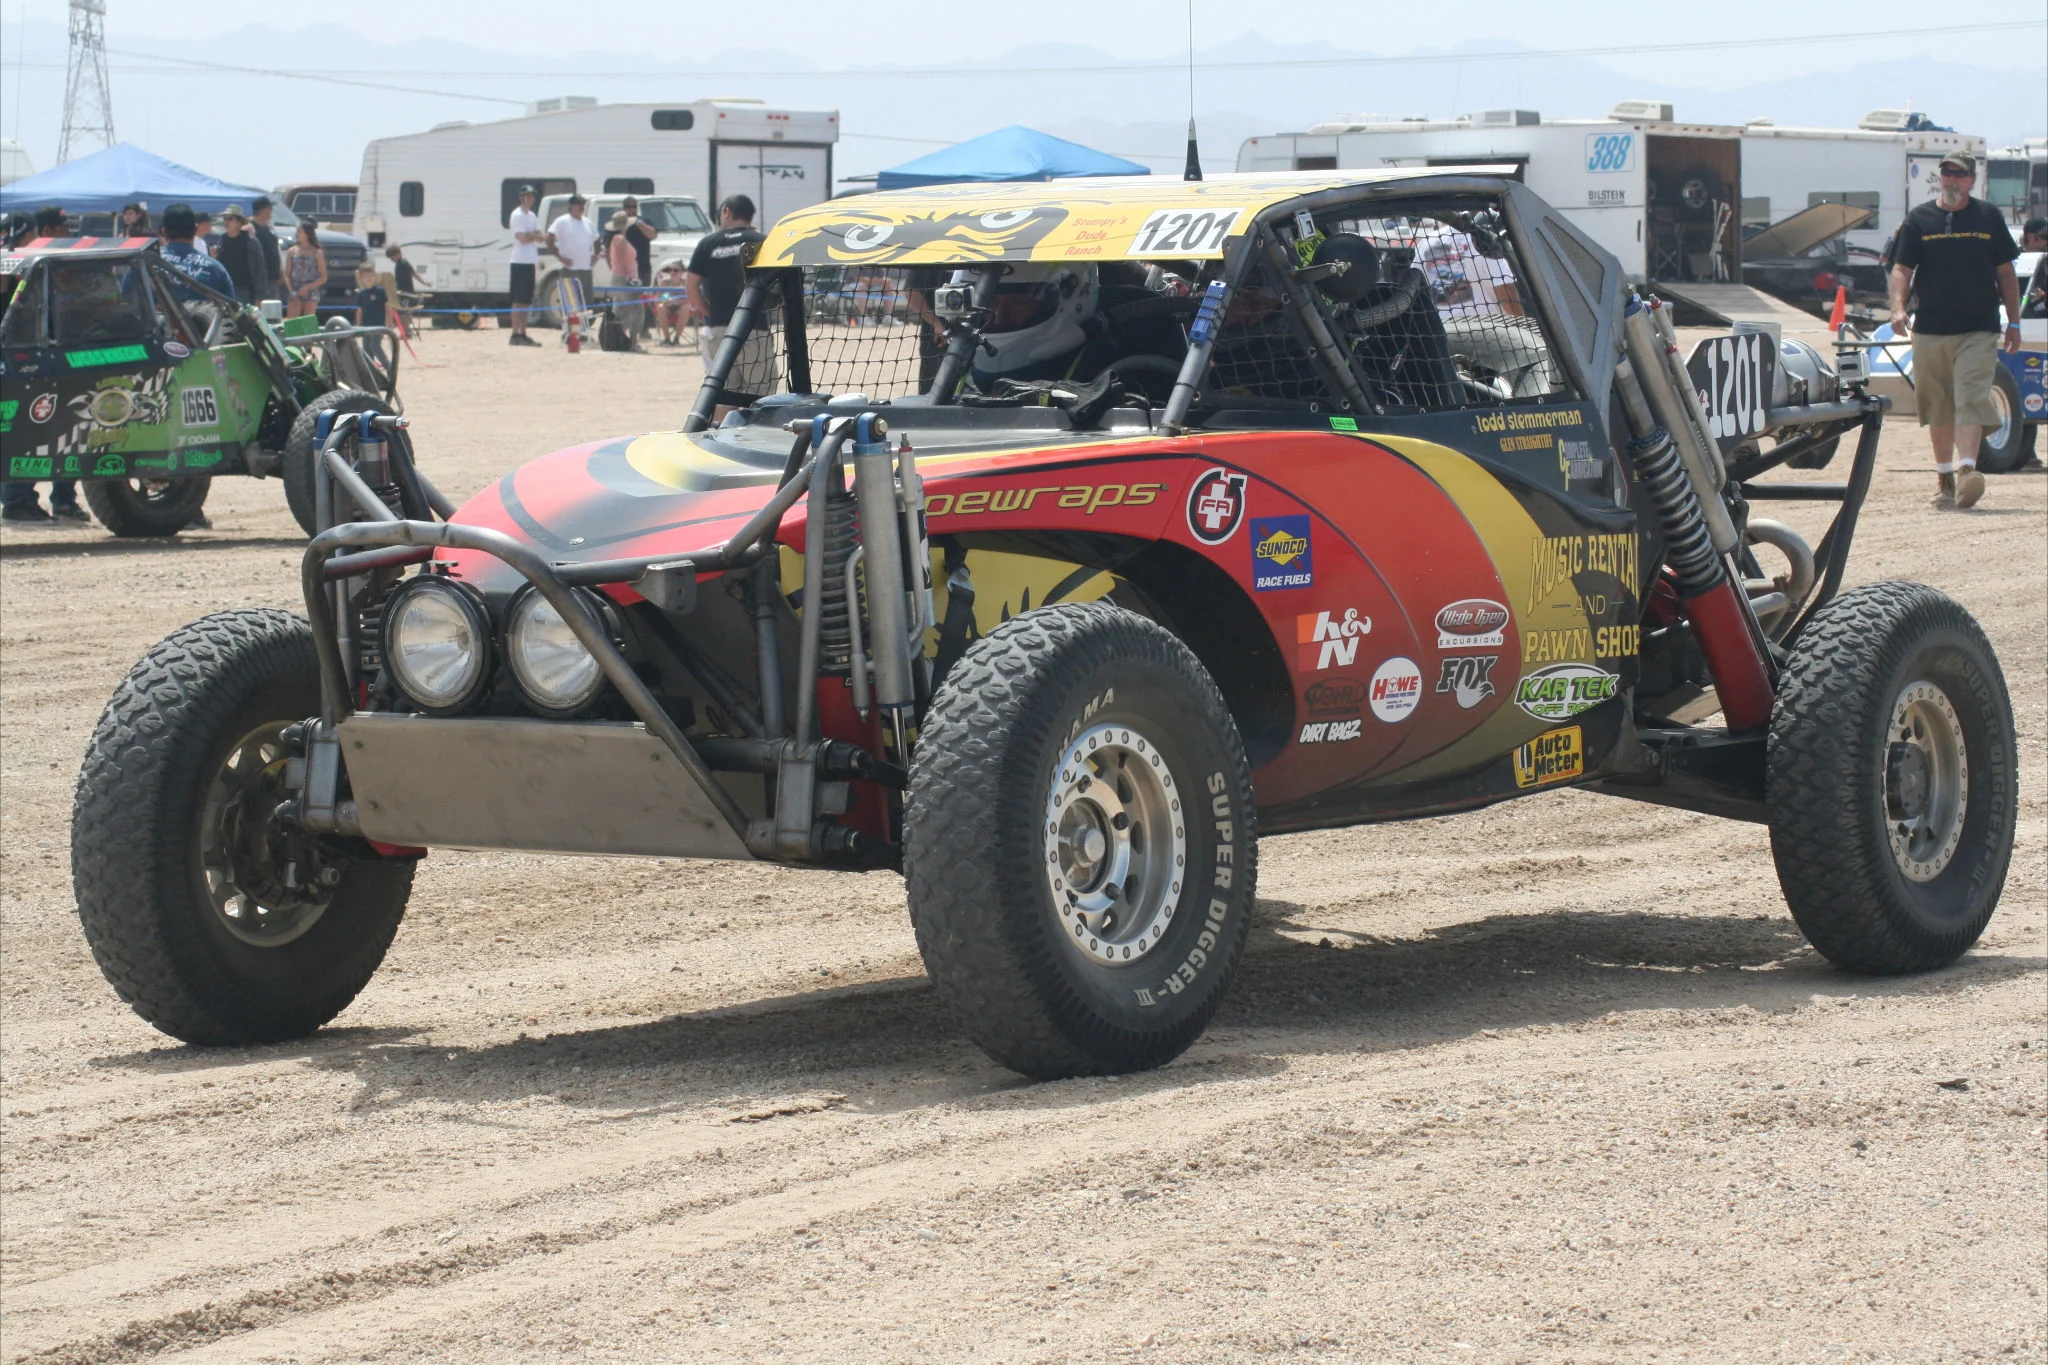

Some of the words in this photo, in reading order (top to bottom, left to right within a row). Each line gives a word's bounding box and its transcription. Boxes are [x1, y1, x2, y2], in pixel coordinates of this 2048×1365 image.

[1588, 135, 1632, 170] 388
[1588, 190, 1626, 200] BILSTEIN
[1138, 211, 1239, 252] 1201
[1064, 245, 1103, 256] Ranch
[1707, 333, 1766, 439] 1201
[182, 389, 217, 424] 1666
[1258, 539, 1306, 557] SUNOCO
[1257, 576, 1282, 588] RACE
[1283, 573, 1311, 586] FUELS
[1527, 536, 1583, 617] MUSIC
[1573, 594, 1606, 616] AND
[1441, 609, 1474, 627] Wide
[1474, 608, 1505, 627] Open
[1439, 636, 1503, 646] EXCURSIONS
[1523, 628, 1589, 662] PAWN
[1436, 655, 1498, 693] FOX
[1532, 703, 1564, 715] OFF
[1299, 722, 1329, 743] DIRT
[1327, 719, 1361, 741] BAGZ
[1535, 734, 1572, 758] Auto
[1534, 752, 1580, 783] Meter
[1206, 771, 1234, 889] SUPER
